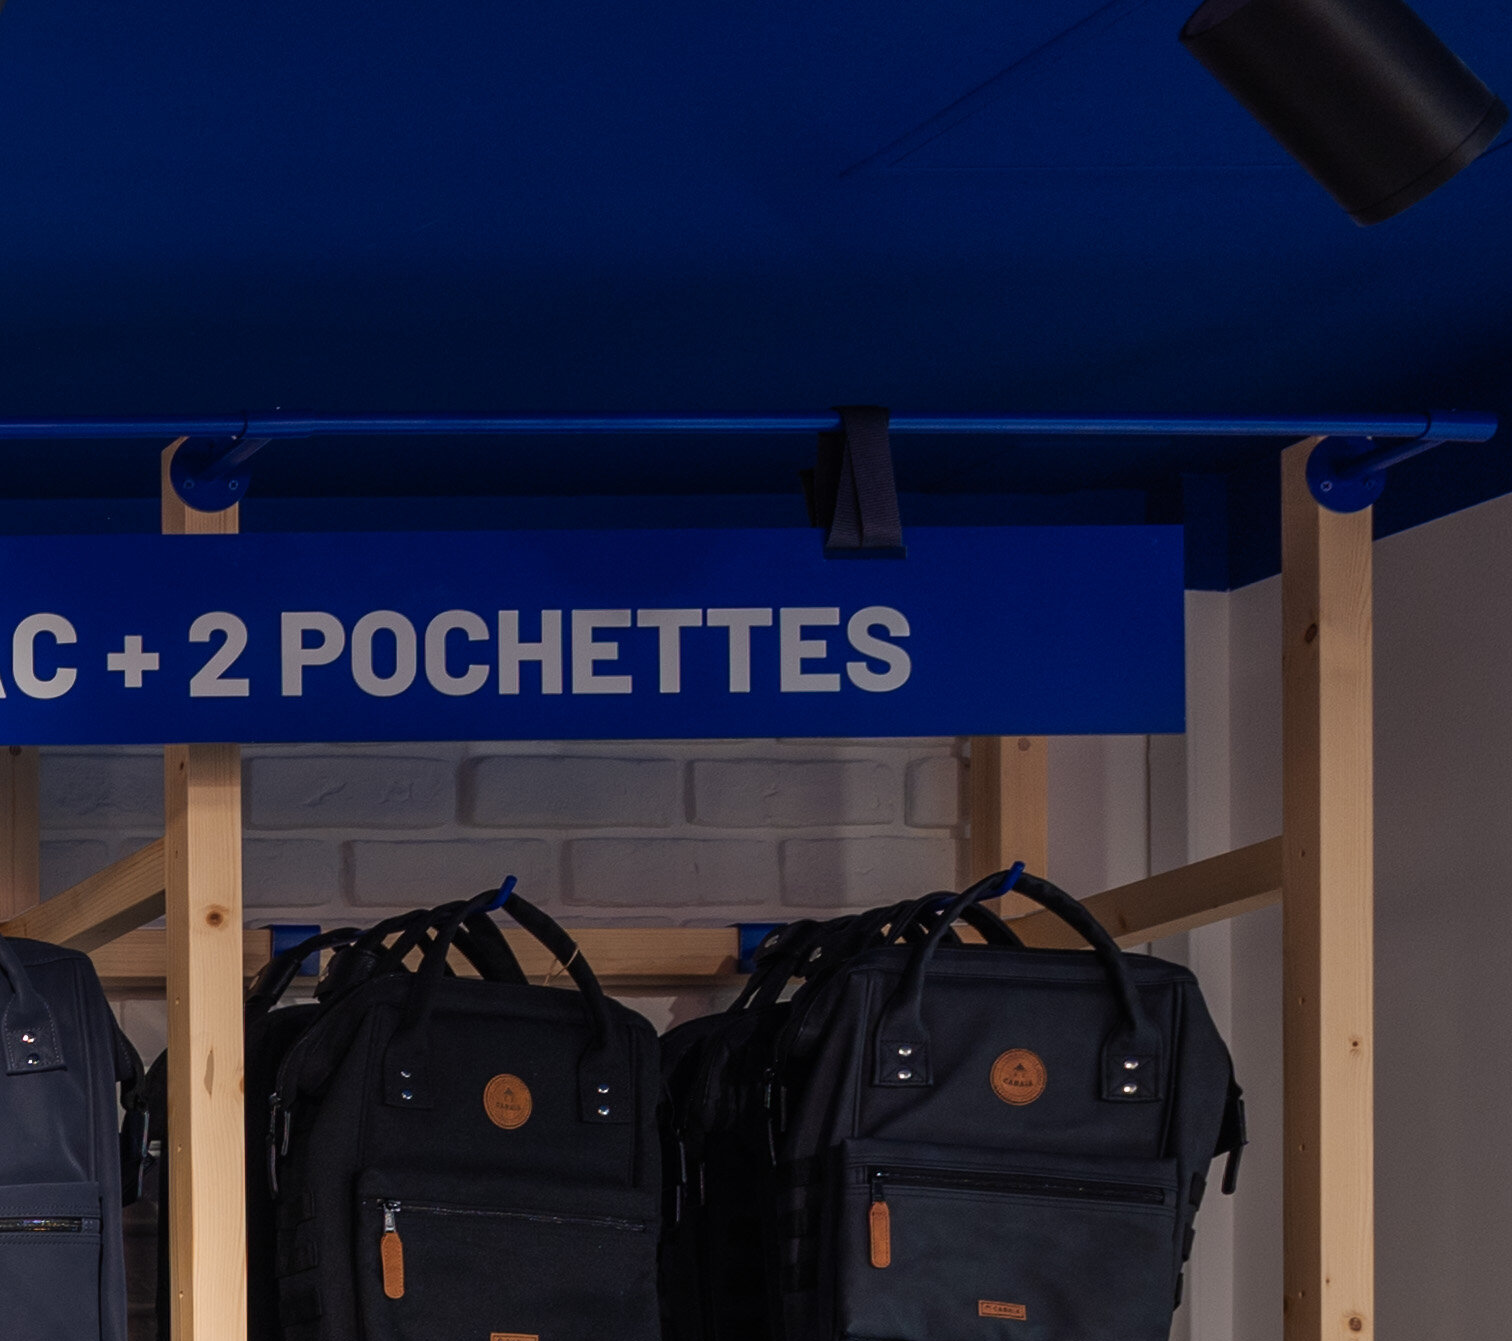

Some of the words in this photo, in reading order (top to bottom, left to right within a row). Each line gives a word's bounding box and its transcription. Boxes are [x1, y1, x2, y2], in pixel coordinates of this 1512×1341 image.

[108, 636, 159, 687] +
[190, 613, 248, 696] 2
[282, 607, 910, 695] POCHETTES
